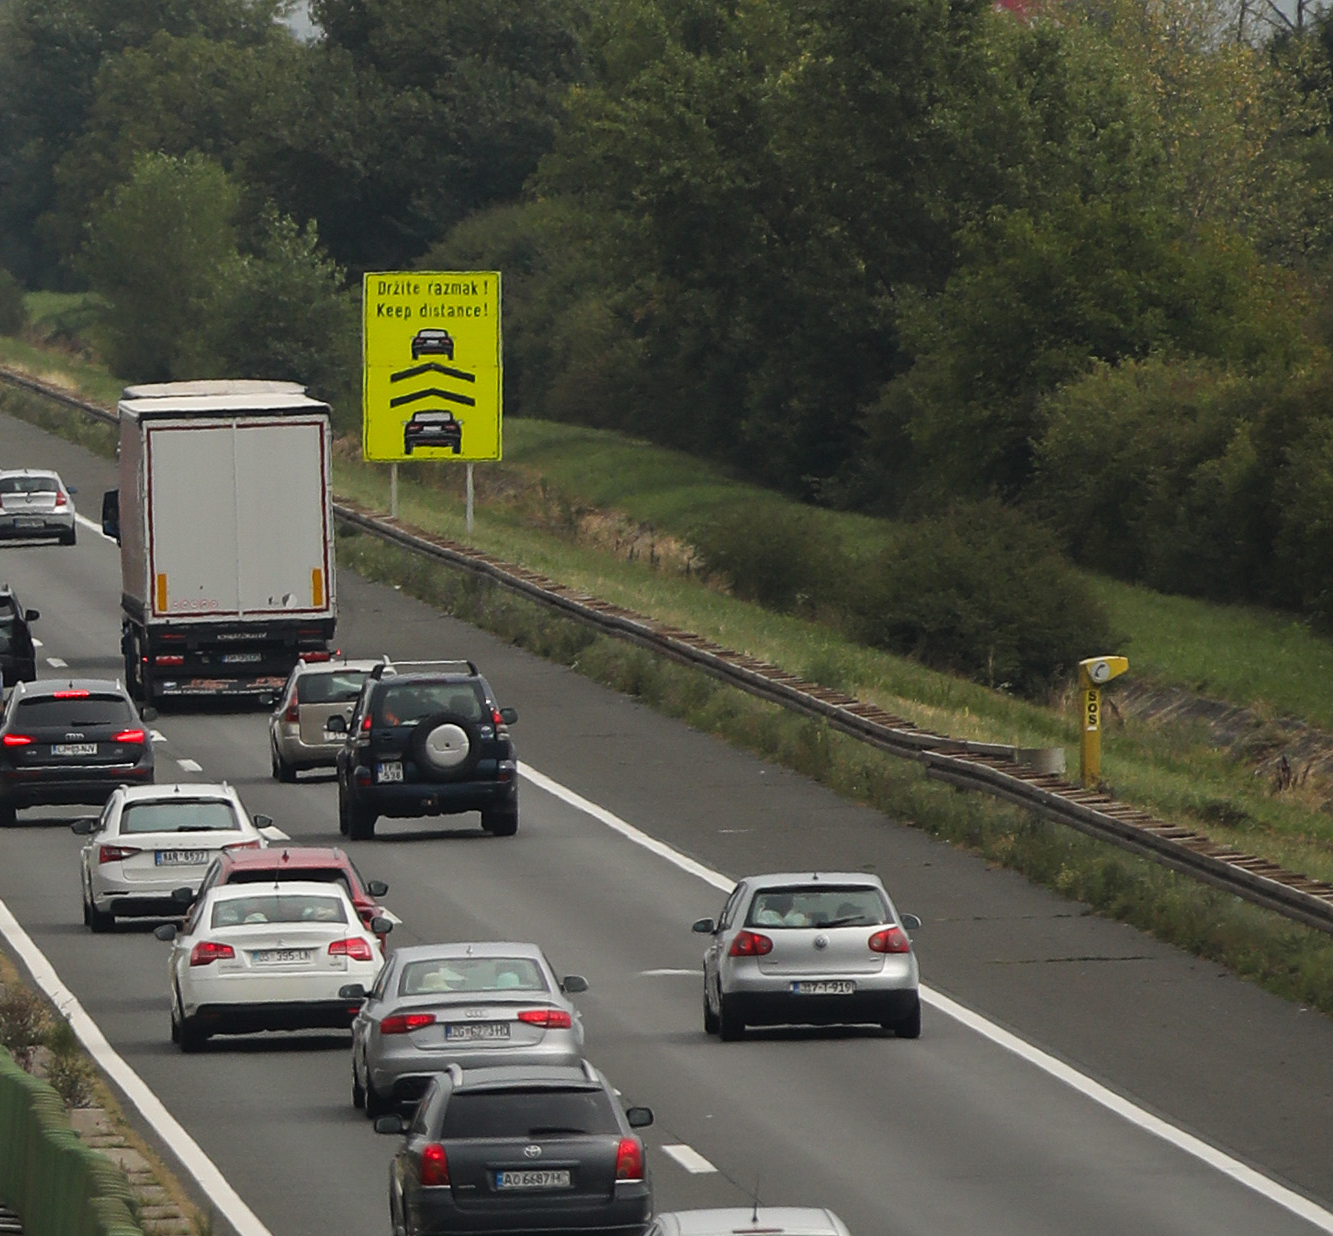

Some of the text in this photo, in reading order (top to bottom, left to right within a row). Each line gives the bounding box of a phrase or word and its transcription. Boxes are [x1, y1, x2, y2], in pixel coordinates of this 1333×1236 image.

[377, 280, 420, 296] Držite
[427, 280, 479, 296] razmak
[376, 303, 489, 320] Keep distance!
[1087, 690, 1098, 725] SOS
